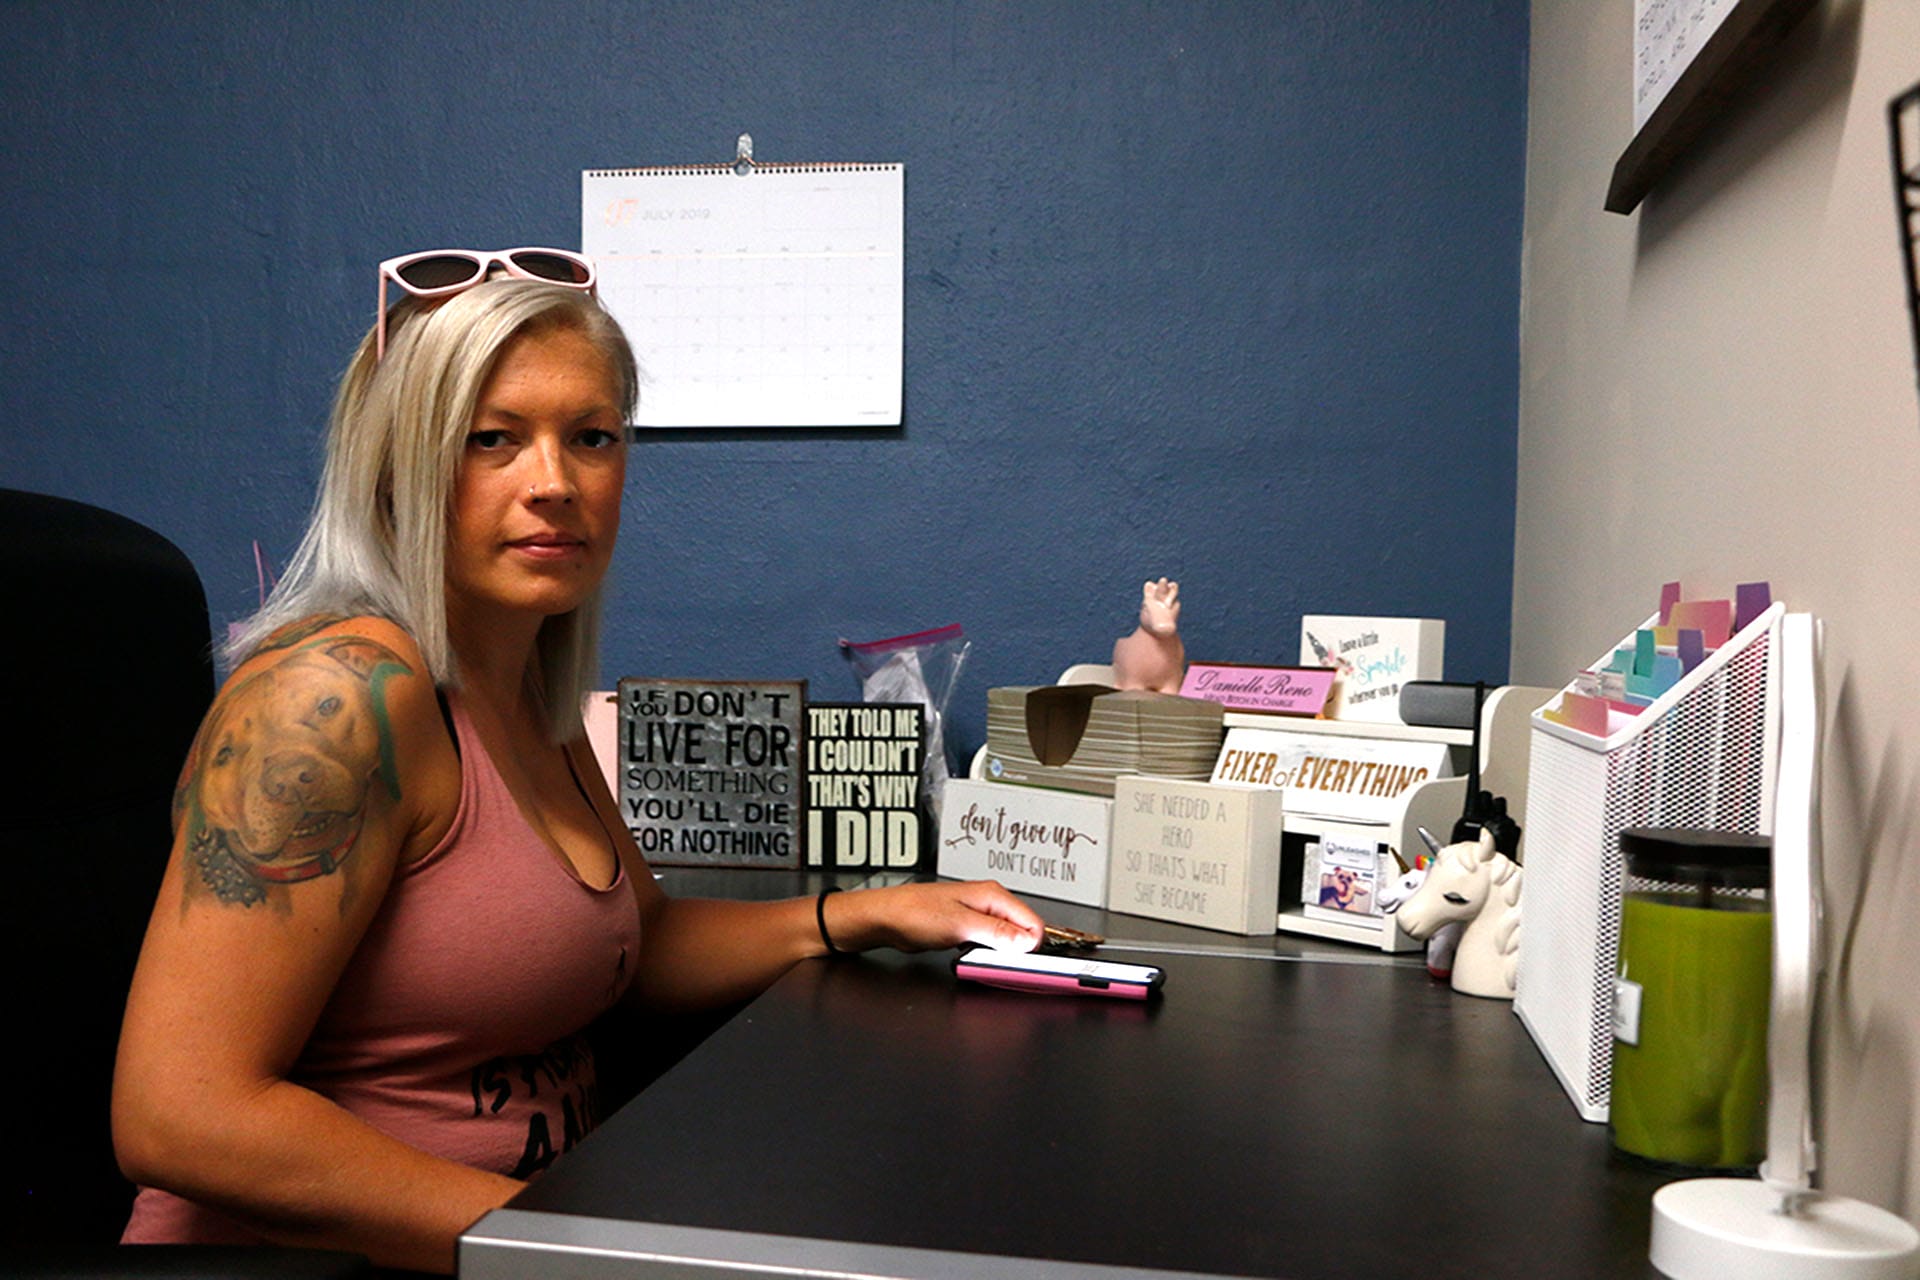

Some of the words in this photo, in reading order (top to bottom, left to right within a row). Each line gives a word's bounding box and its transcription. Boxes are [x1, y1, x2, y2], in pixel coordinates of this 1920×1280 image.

[642, 208, 675, 221] JULY
[679, 207, 711, 220] 2019
[633, 690, 665, 702] IF
[1194, 670, 1264, 693] Danielle
[1263, 674, 1313, 697] Reno
[630, 703, 668, 716] YOU
[674, 691, 790, 719] DON'T
[1261, 697, 1295, 708] CHARGE
[808, 708, 849, 737] THEY
[851, 708, 892, 738] TOLD
[894, 709, 919, 738] ME
[628, 721, 706, 764] LIVE
[726, 724, 790, 767] FOR
[808, 740, 815, 772] I
[820, 739, 919, 772] COULDN'T
[627, 768, 789, 795] SOMETHING
[1219, 749, 1279, 785] FIXER
[1273, 767, 1297, 788] of
[808, 774, 871, 808] THAT'S
[873, 775, 918, 808] WHY
[628, 798, 729, 822] YOU'LL
[744, 802, 789, 824] DIE
[1133, 791, 1156, 814] SHE
[1162, 795, 1210, 820] NEEDED
[1216, 801, 1227, 823] A
[681, 828, 789, 857] NOTHING
[808, 810, 823, 866] I
[836, 810, 919, 867] DID
[959, 803, 1008, 844] don't
[1010, 820, 1050, 850] give
[1053, 825, 1088, 859] up
[1161, 826, 1193, 849] HERO
[988, 849, 1026, 873] DON'T
[1029, 855, 1057, 879] GIVE
[1060, 861, 1077, 881] IN
[1126, 849, 1142, 873] SO
[1192, 858, 1228, 886] WHAT
[1134, 881, 1156, 906] SHE
[1161, 886, 1208, 914] BECAME
